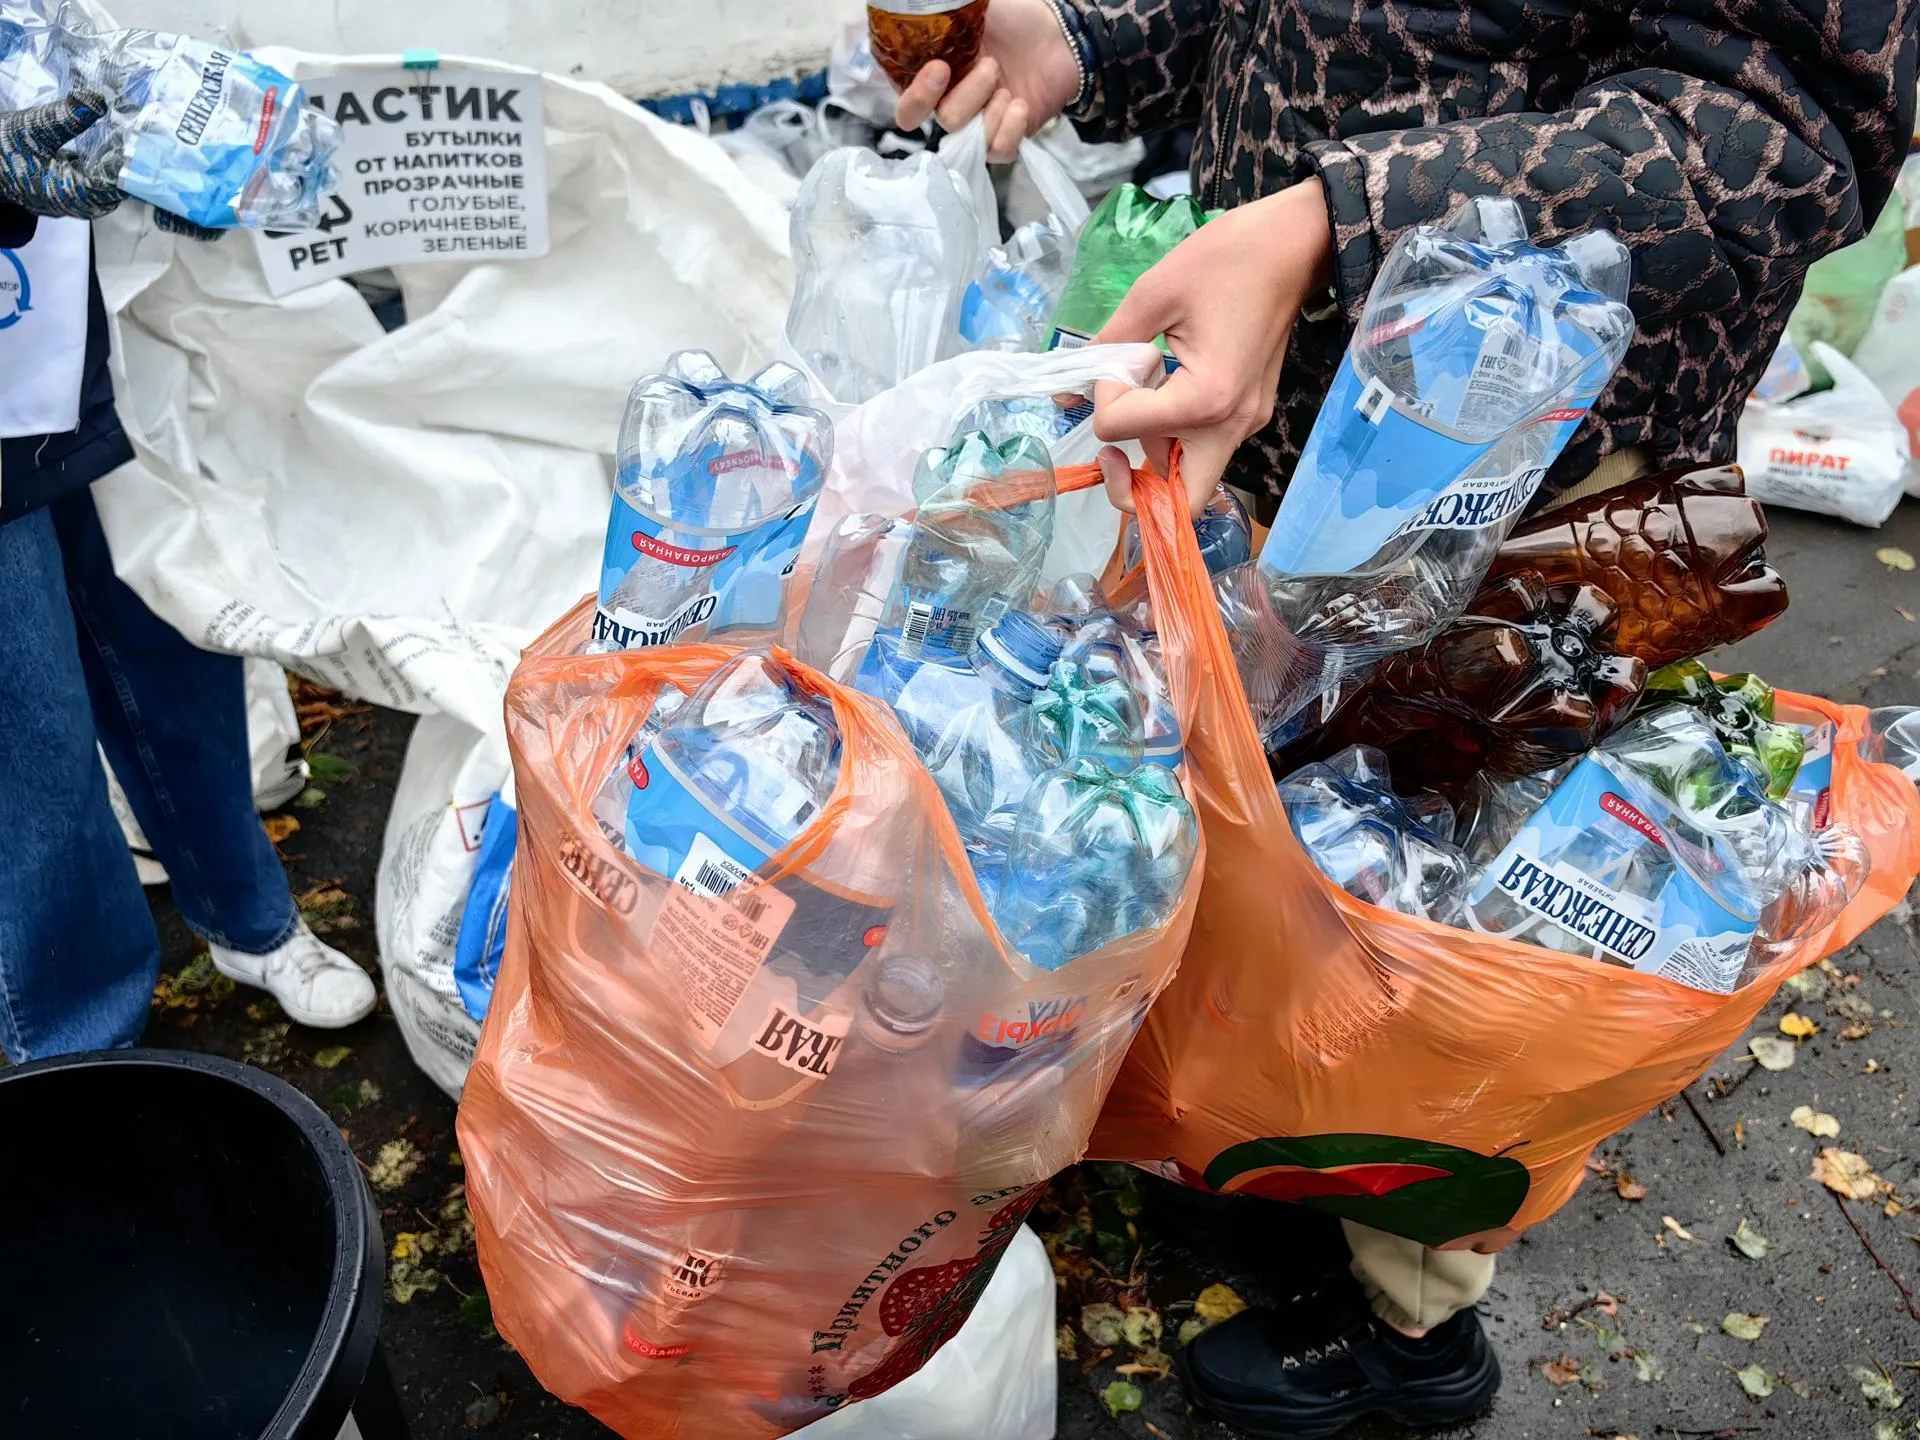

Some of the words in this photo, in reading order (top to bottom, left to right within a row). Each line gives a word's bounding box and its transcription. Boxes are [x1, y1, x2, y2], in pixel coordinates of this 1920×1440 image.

[406, 131, 521, 147] БУТЫЛКИ
[355, 157, 386, 174] ОТ
[395, 153, 523, 171] НАПИТКОВ
[364, 175, 524, 195] ПРОЗРАЧНЫЕ
[410, 196, 525, 212] ГОЛУБЫЕ,
[364, 215, 527, 238] КОРИЧНЕВЫЕ,
[289, 237, 348, 270] PET
[423, 235, 527, 253] ЗЕЛЕНЫЕ
[1769, 447, 1852, 471] ПИРАТ
[1577, 877, 1617, 902] ПИТЬЕВАЯ
[1498, 853, 1657, 961] СЕНЕЖСКАЯ
[811, 1208, 958, 1354] Приятного
